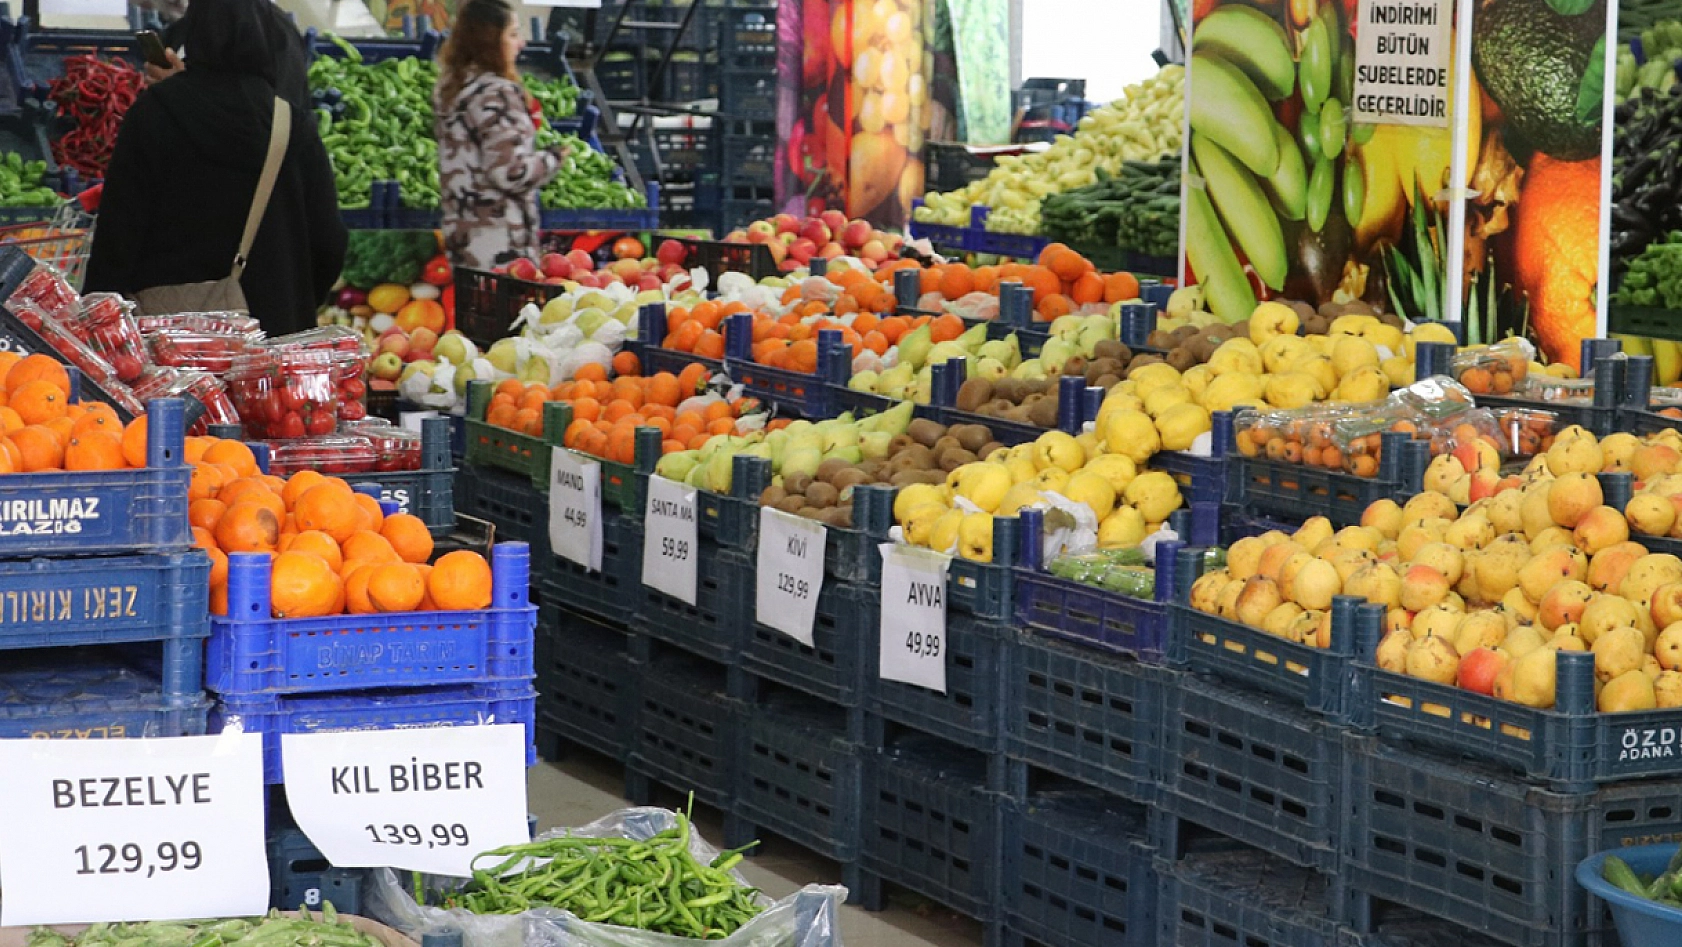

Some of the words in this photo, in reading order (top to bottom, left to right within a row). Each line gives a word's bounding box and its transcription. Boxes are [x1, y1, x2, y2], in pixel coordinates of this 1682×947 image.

[1370, 1, 1437, 25] İNDİRİMİ
[1377, 32, 1429, 55] BÜTÜN
[1358, 65, 1446, 87] ŞUBELERDE
[1357, 93, 1445, 117] GEÇERLİDİR
[0, 497, 100, 521] IRILMAZ
[564, 507, 587, 527] 44,99
[651, 498, 678, 518] SANTA
[662, 536, 688, 561] 59,99
[786, 534, 807, 558] KİVİ
[778, 572, 809, 599] 129,99
[907, 581, 942, 609] AYVA
[0, 588, 72, 624] KIRIL
[906, 631, 940, 658] 49,99
[1621, 728, 1682, 748] ÖZD
[1619, 745, 1674, 761] ADANA
[331, 766, 379, 794] KIL
[390, 756, 484, 791] BİBER
[52, 772, 212, 808] BEZELYE
[365, 823, 469, 849] 139,99
[74, 840, 202, 878] 129,99
